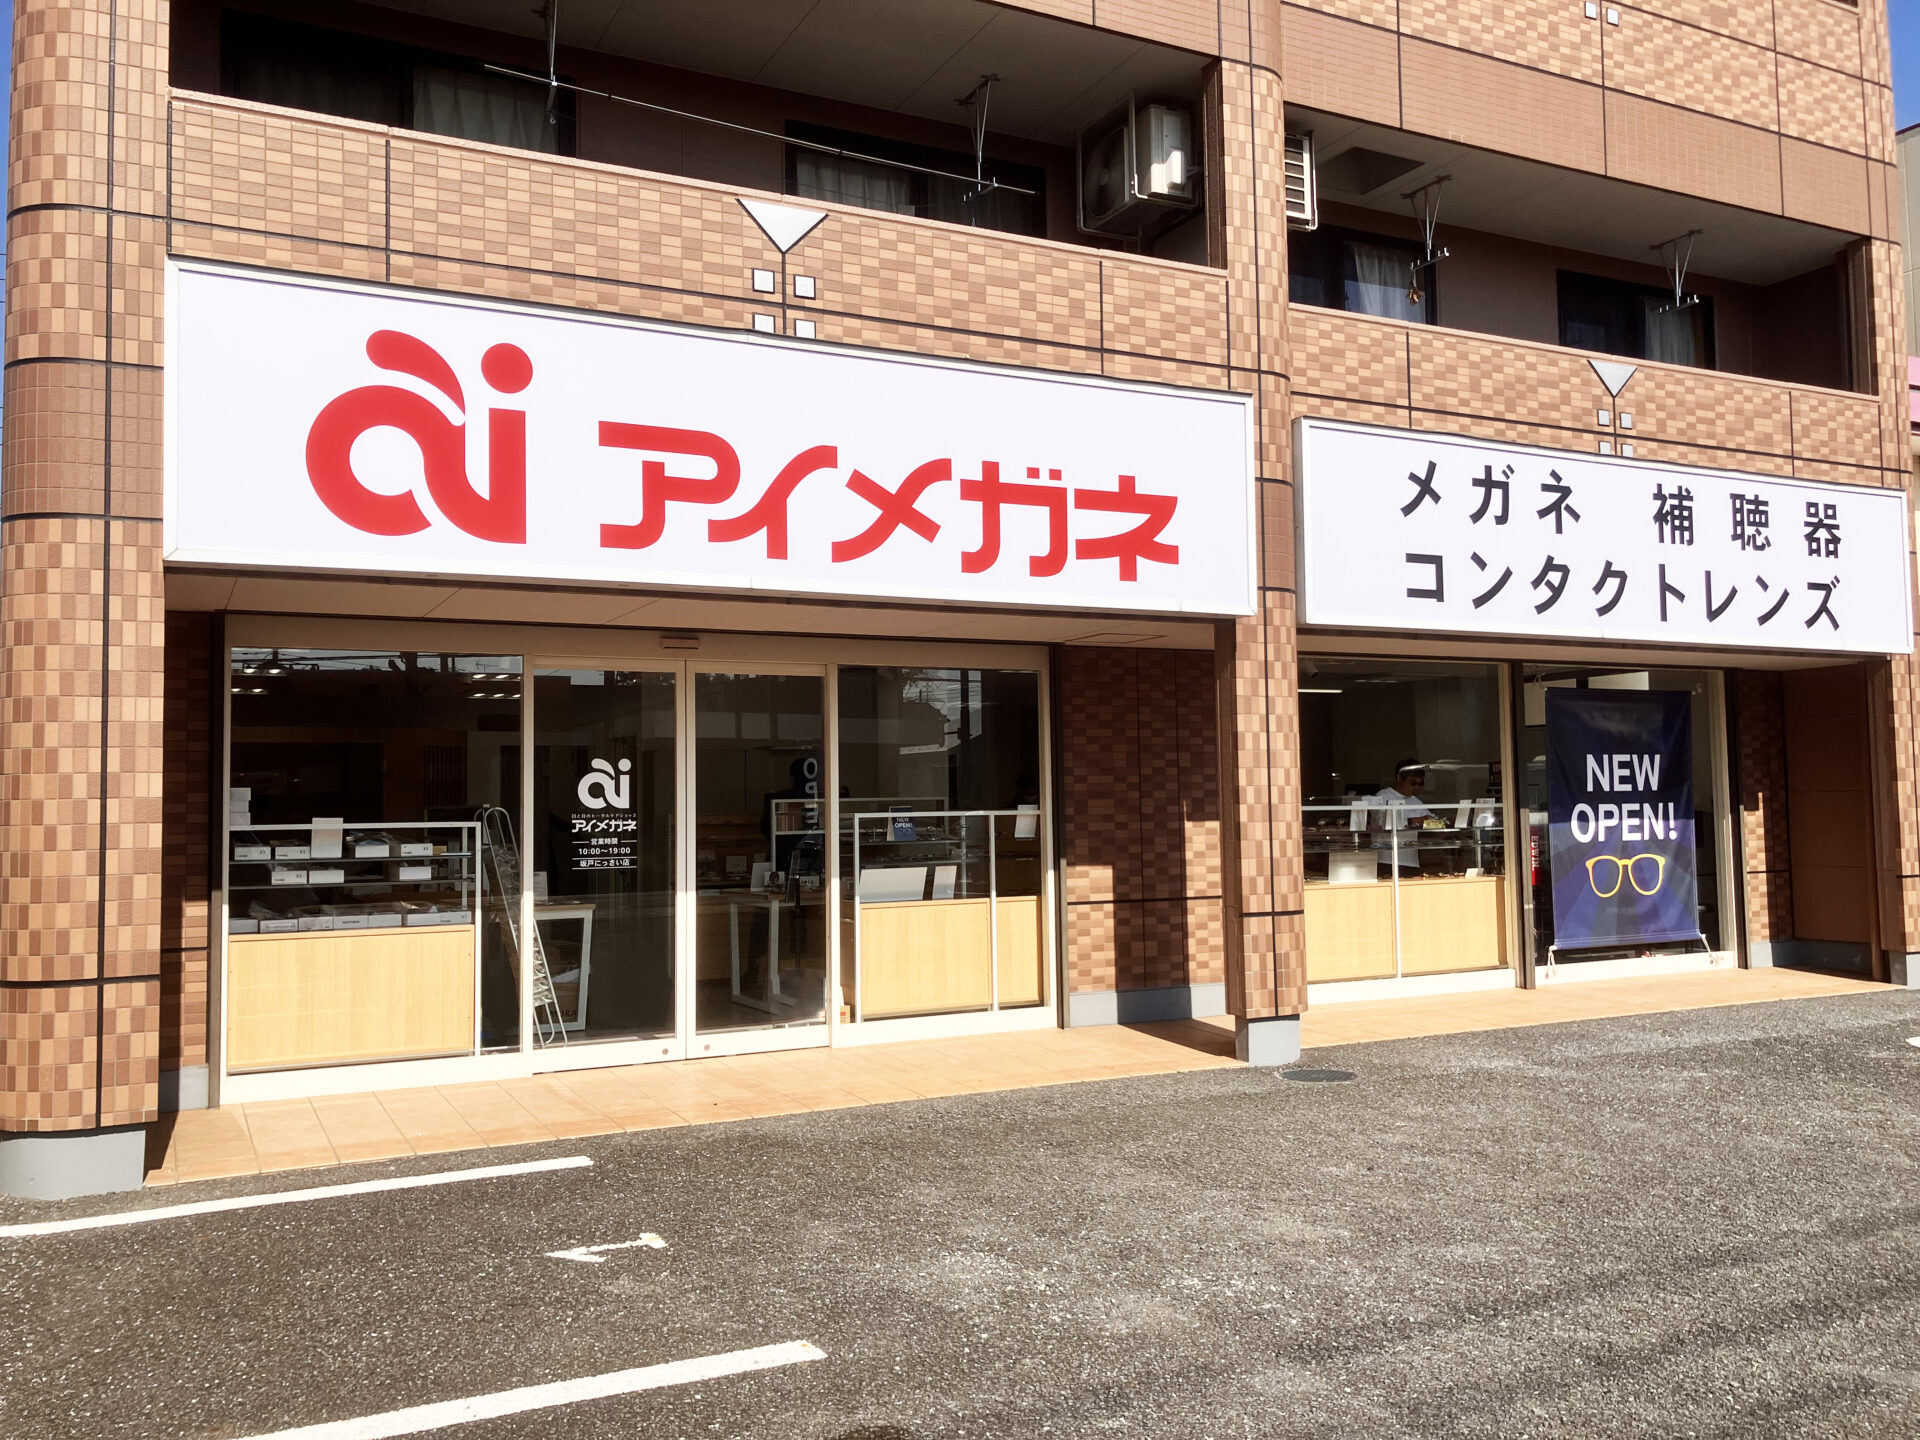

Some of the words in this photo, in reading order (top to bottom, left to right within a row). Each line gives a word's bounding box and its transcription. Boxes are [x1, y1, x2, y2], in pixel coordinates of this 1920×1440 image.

[599, 421, 1179, 582] アイメガネ
[1400, 459, 1581, 535] メガネ
[1652, 483, 1842, 559] 補聴器
[1404, 551, 1840, 631] コンタクトレンズ
[1586, 754, 1661, 792] NEW
[571, 819, 637, 833] アイメガネ
[590, 837, 619, 846] 営業時間
[1570, 802, 1677, 843] OPEN!
[579, 859, 630, 868] 坂戸にっさい店
